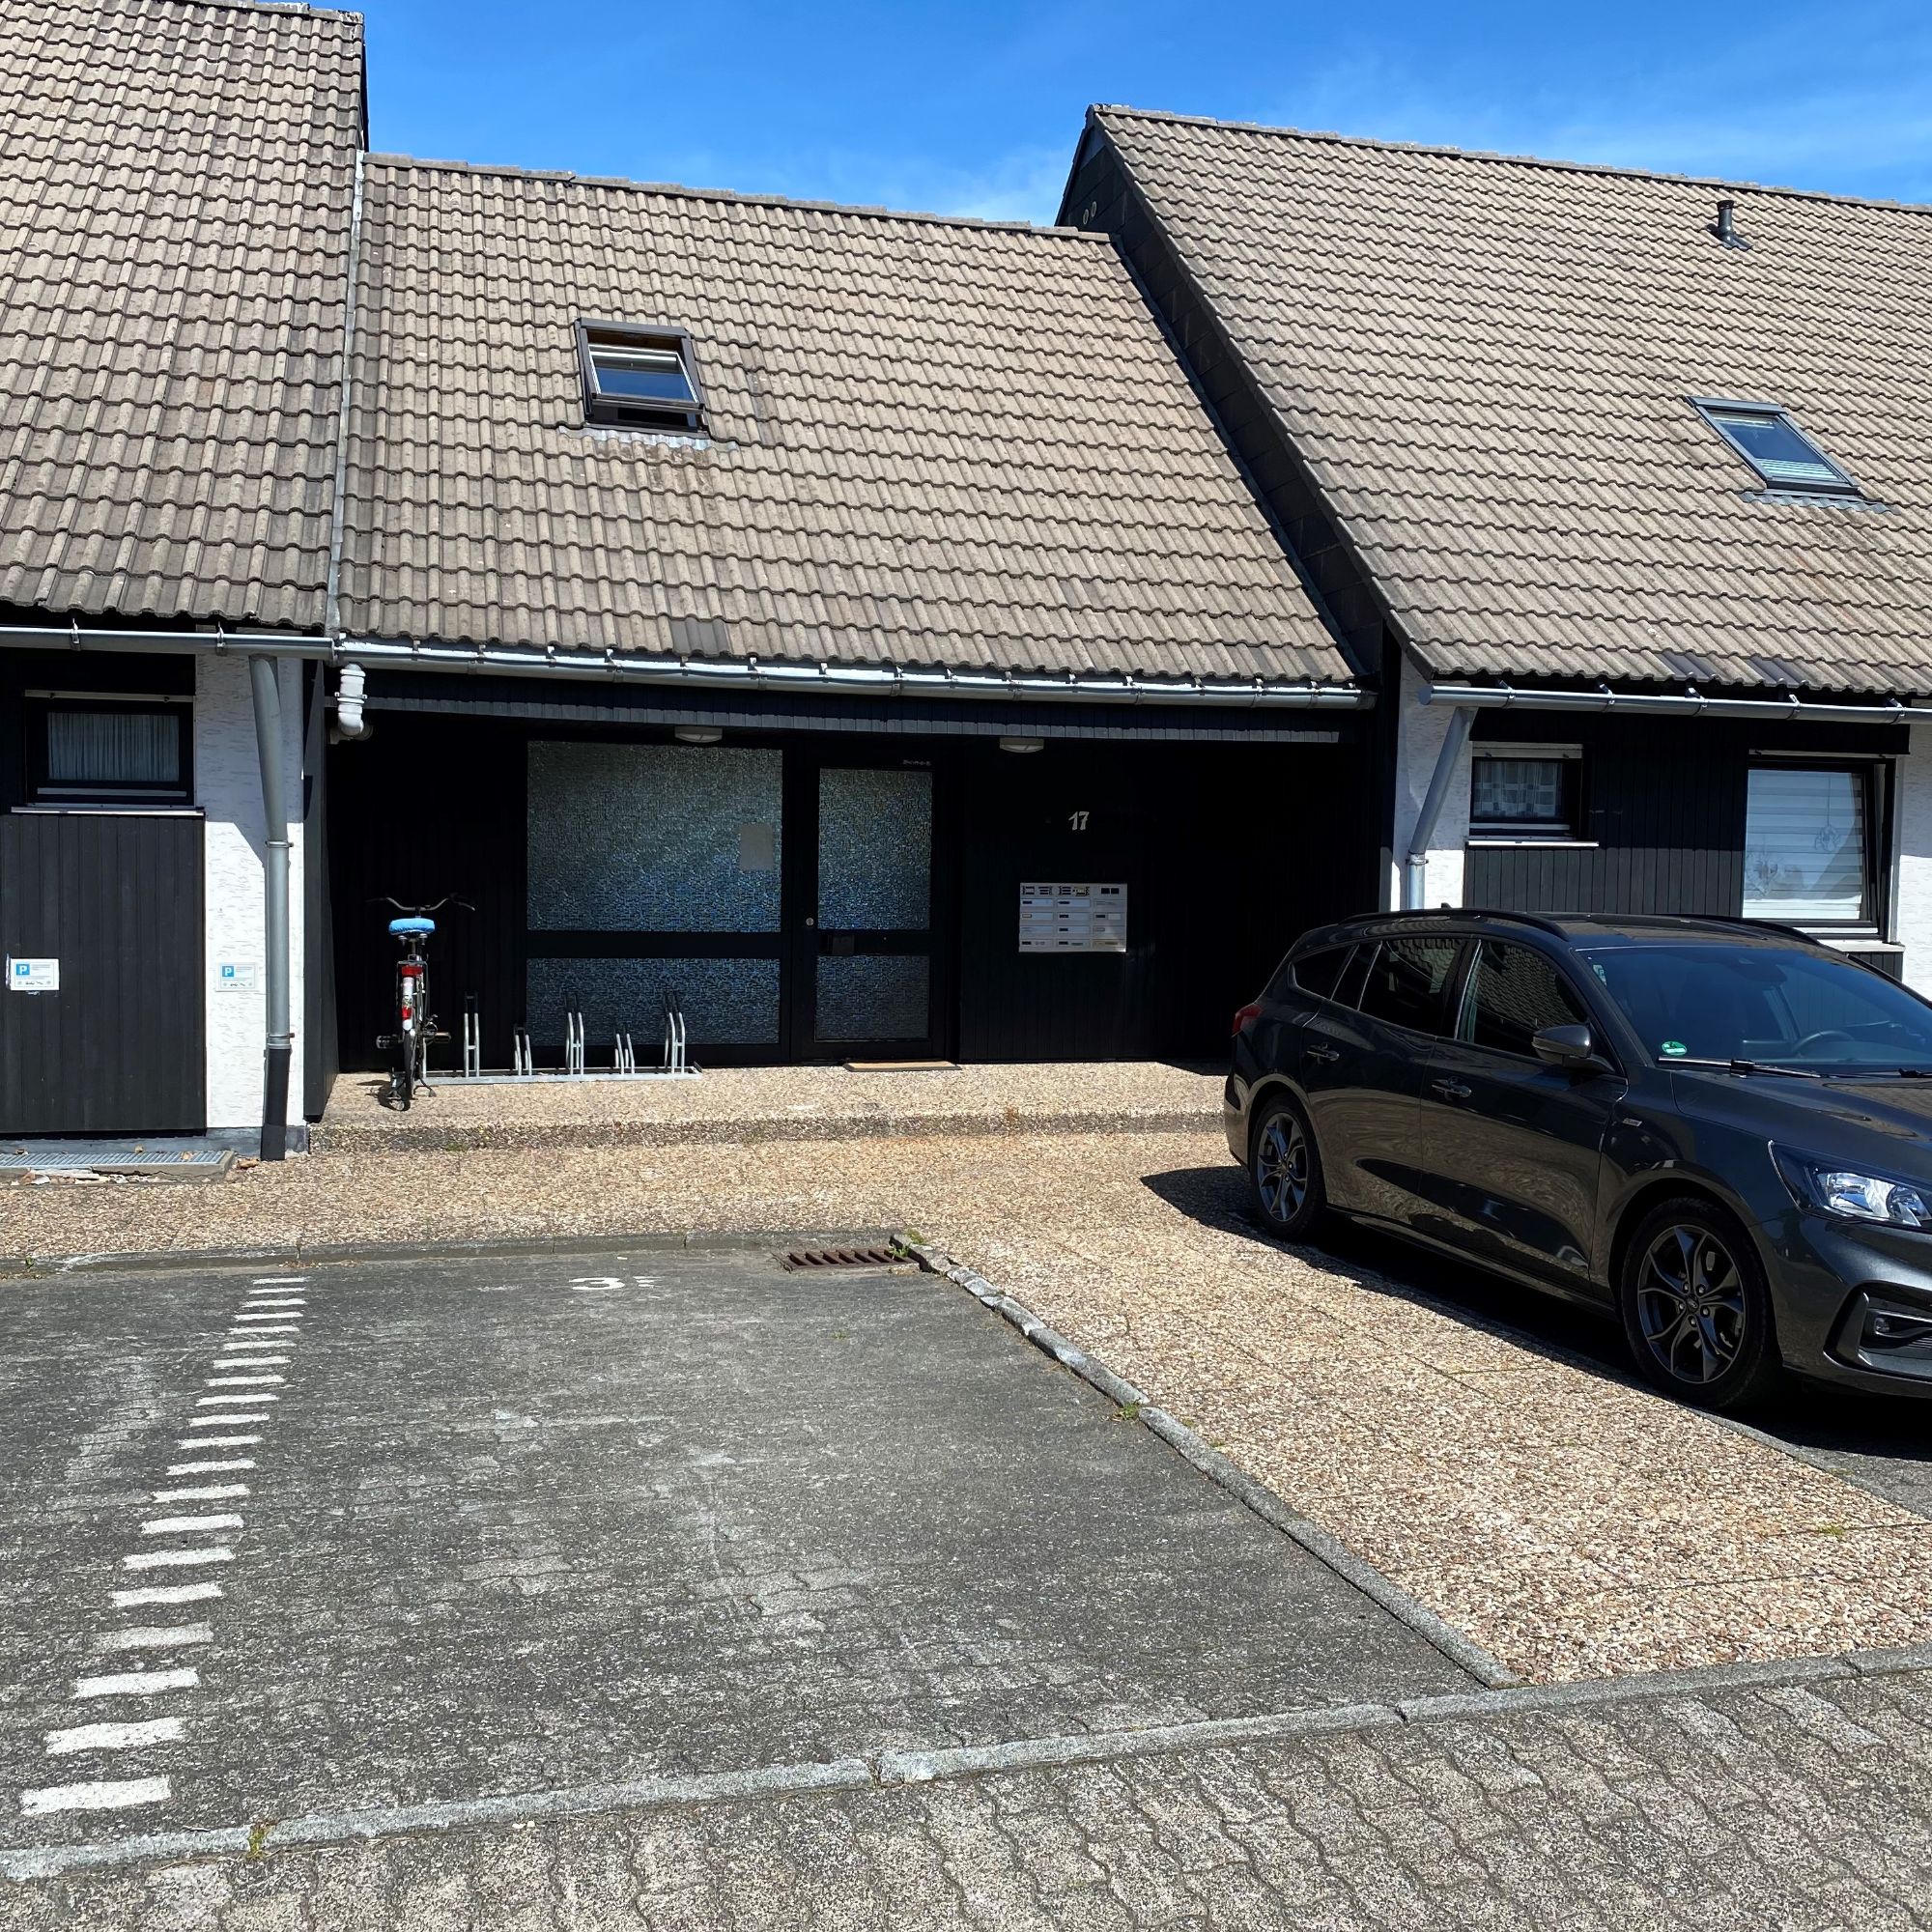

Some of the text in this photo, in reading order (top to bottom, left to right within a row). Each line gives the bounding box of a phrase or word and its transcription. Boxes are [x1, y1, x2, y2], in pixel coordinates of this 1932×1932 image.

[1068, 810, 1090, 831] 17
[18, 965, 28, 975] P
[224, 967, 233, 976] P
